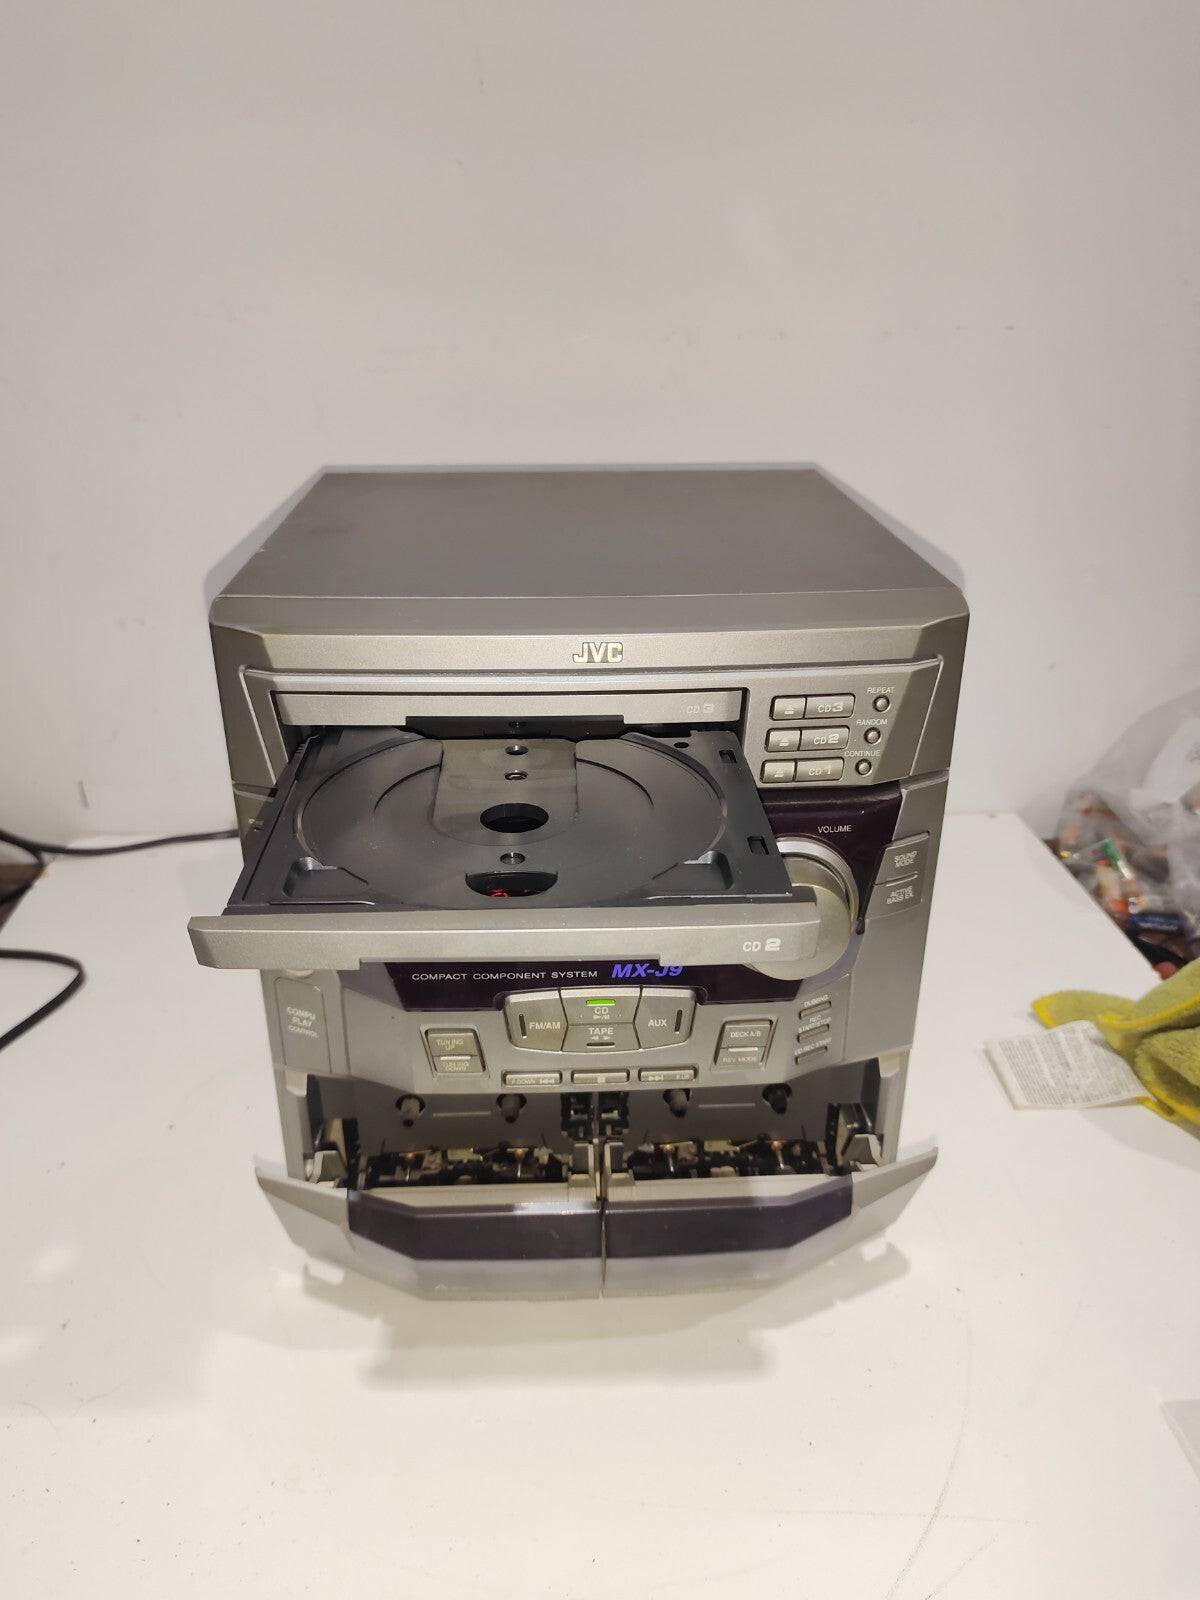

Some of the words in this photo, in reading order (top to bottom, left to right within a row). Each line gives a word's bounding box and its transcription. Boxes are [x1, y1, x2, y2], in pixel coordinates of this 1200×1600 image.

[572, 641, 624, 664] JVC
[686, 705, 701, 715] CD
[703, 703, 714, 715] 3
[856, 719, 888, 727] RANDOM
[844, 750, 881, 759] CONTINUE
[817, 824, 853, 834] VOLUME
[894, 850, 918, 863] SOUND
[895, 858, 914, 868] MODE
[889, 885, 913, 899] ACTIVE
[886, 894, 903, 905] BASS
[742, 941, 761, 952] CD
[764, 938, 781, 951] 2
[411, 973, 468, 981] COMPACT
[472, 971, 547, 980] COMPONENT
[551, 970, 598, 979] SYSTEM
[611, 963, 684, 979] MX-J9
[286, 1006, 316, 1021] COMPU
[594, 1006, 609, 1015] CD
[291, 1016, 313, 1027] PLAY
[529, 1021, 561, 1030] FM/AM
[647, 1018, 668, 1027] AUX
[288, 1024, 320, 1039] CONTROL
[588, 1027, 614, 1036] TAPE
[437, 1038, 464, 1046] TUNING
